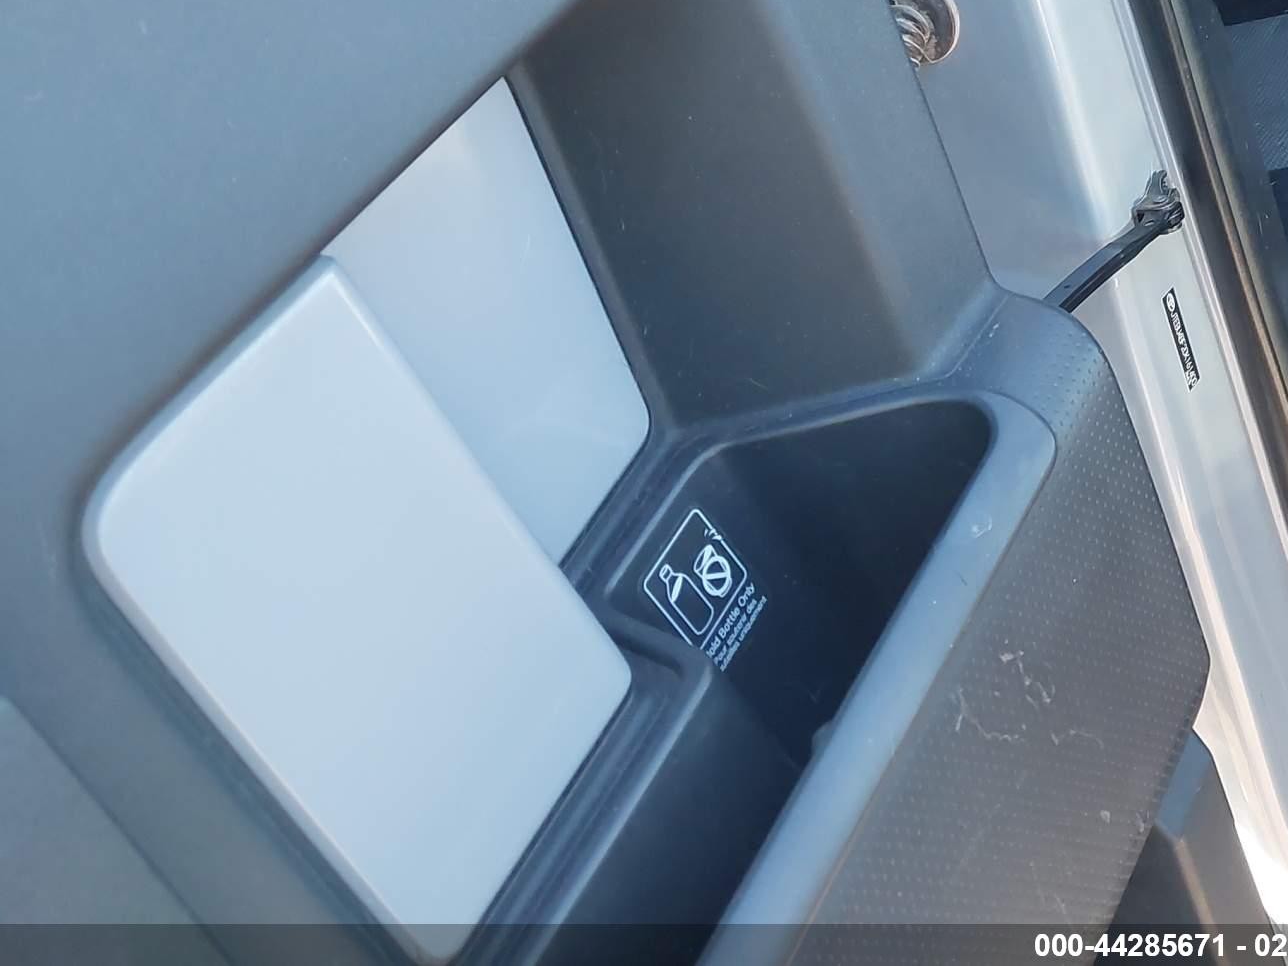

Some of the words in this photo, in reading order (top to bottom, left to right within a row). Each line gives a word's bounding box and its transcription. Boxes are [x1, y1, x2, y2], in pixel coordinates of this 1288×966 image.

[718, 606, 741, 639] Bottle
[737, 582, 755, 607] Only
[746, 598, 758, 614] des
